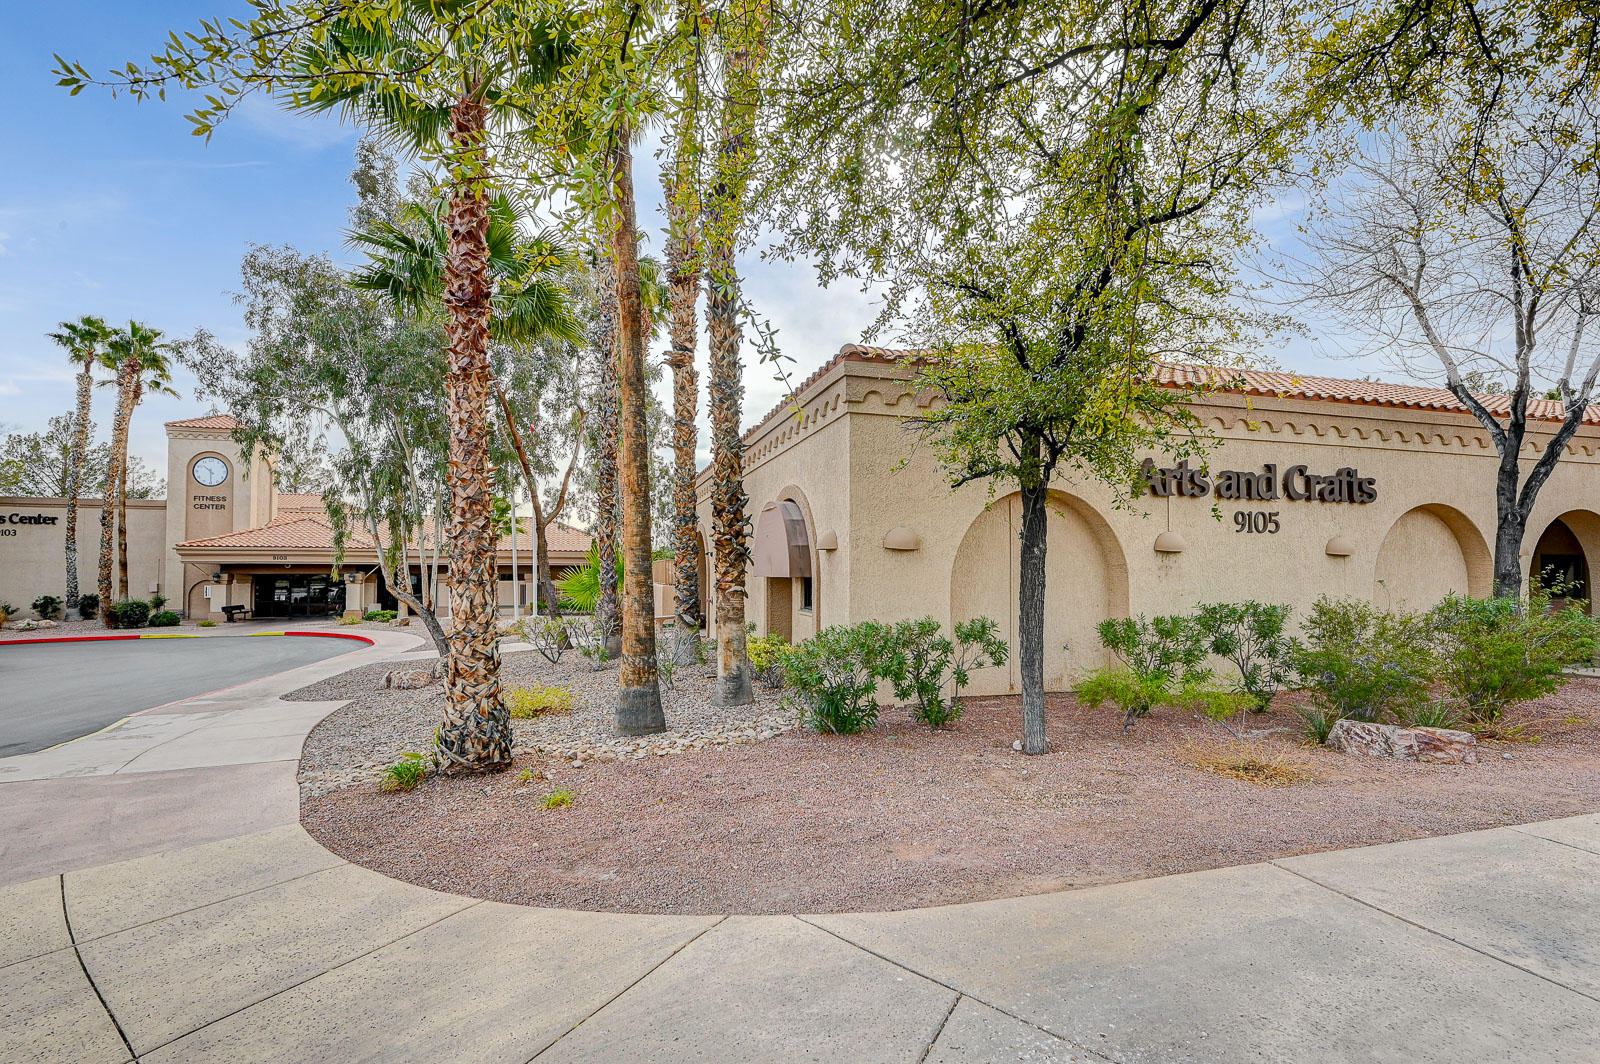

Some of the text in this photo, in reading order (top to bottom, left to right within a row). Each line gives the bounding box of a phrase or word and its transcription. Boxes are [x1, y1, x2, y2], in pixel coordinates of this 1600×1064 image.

[1131, 458, 1378, 503] Arts and Crafts
[9, 513, 59, 525] Center
[1234, 511, 1280, 534] 9105
[0, 529, 17, 537] 103
